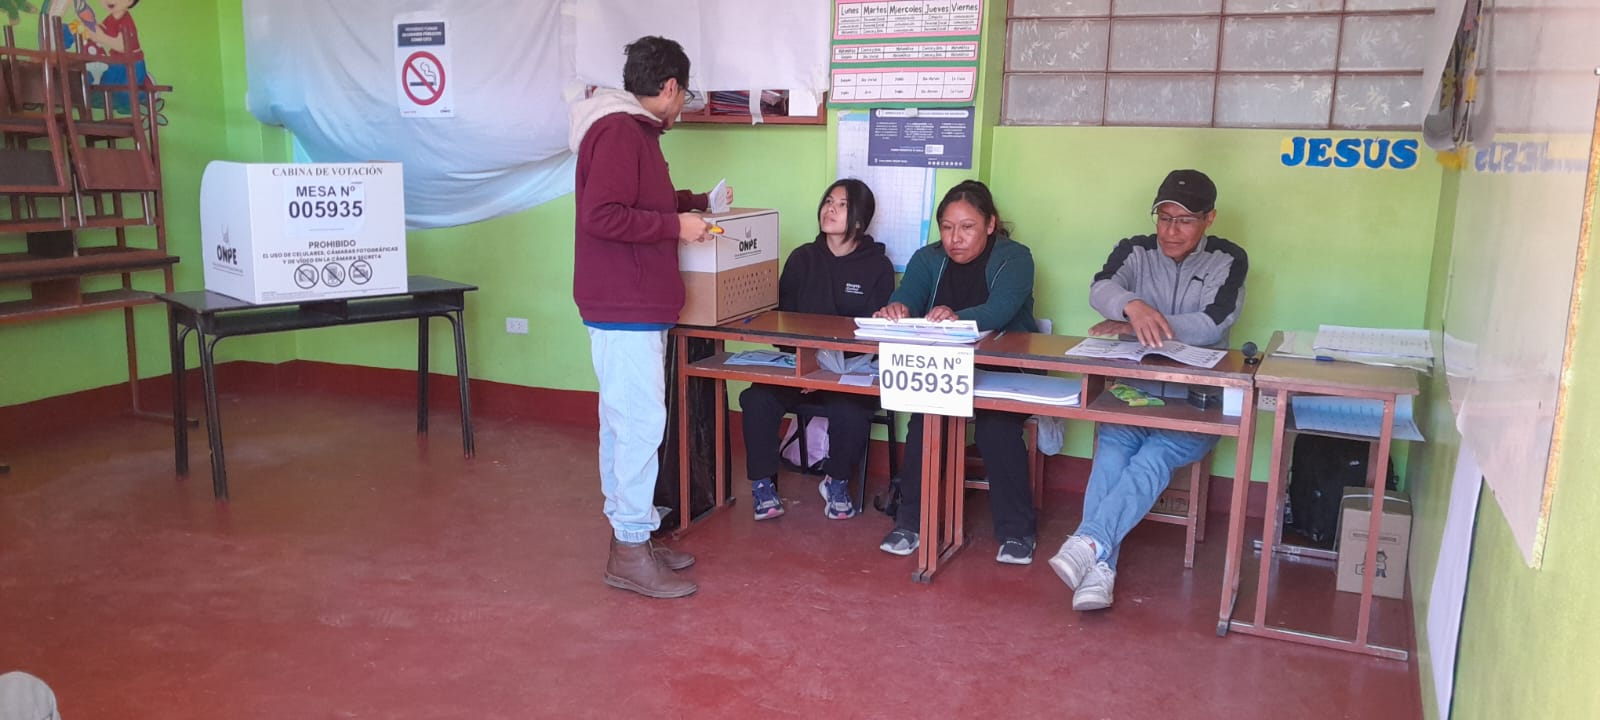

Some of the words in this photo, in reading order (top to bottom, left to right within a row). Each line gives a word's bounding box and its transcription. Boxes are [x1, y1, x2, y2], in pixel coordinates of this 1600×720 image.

[841, 5, 860, 16] Lunes
[863, 5, 887, 15] Martes
[925, 3, 949, 14] Jueves
[951, 2, 978, 13] Viernes
[272, 167, 313, 177] CABINA
[315, 167, 330, 176] DE
[331, 165, 384, 176] VOTACIÓN
[296, 185, 337, 197] MESA
[288, 200, 363, 219] 005935
[308, 240, 356, 249] PROHIBIDO
[738, 238, 758, 252] ONPE
[216, 244, 238, 266] ONPE
[357, 253, 382, 261] SECRETA
[891, 353, 938, 370] MESA
[881, 369, 970, 395] 005935
